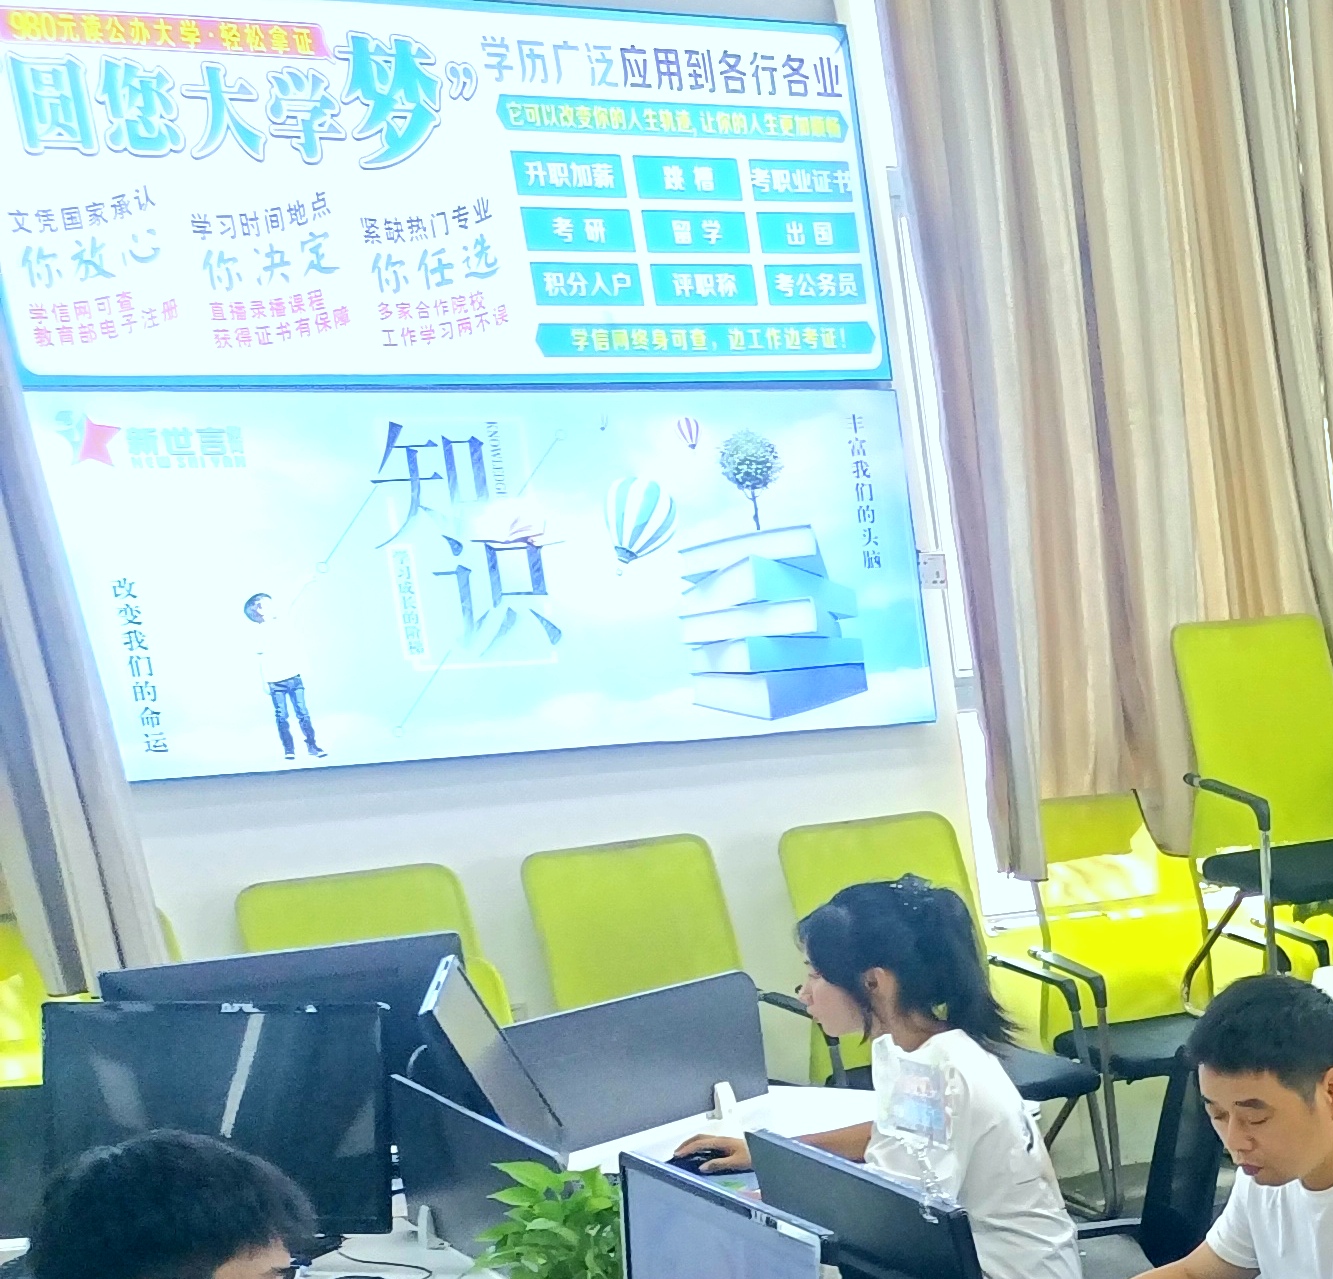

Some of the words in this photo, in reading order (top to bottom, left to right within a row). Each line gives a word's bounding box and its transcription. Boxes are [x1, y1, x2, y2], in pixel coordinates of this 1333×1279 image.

[481, 35, 843, 98] 学历广泛应用到各行各业
[524, 160, 616, 190] 升职加薪
[750, 167, 853, 194] 考职业证书
[8, 185, 156, 234] 文凭国家承认
[190, 191, 332, 240] 学习时间地点
[360, 197, 493, 244] 紧缺热门专业
[551, 216, 606, 244] 考研
[671, 219, 723, 246] 留学
[785, 221, 834, 247] 出国
[21, 228, 161, 289] 你放心
[203, 231, 340, 292] 你决定
[371, 233, 500, 294] 你任选
[210, 289, 325, 322] 直播录播课程
[378, 291, 485, 320] 多家合作院校
[543, 273, 632, 297] 积分入户
[672, 273, 739, 297] 评职称
[774, 273, 859, 298] 考公务员
[29, 291, 134, 324] 学信网可查
[34, 299, 179, 348] 教育部电子注册
[213, 306, 350, 348] 获得证书有保障
[383, 304, 509, 347] 工作学习两不误
[846, 413, 884, 571] 丰富我们的头脑
[111, 577, 169, 755] 改变我们的命运
